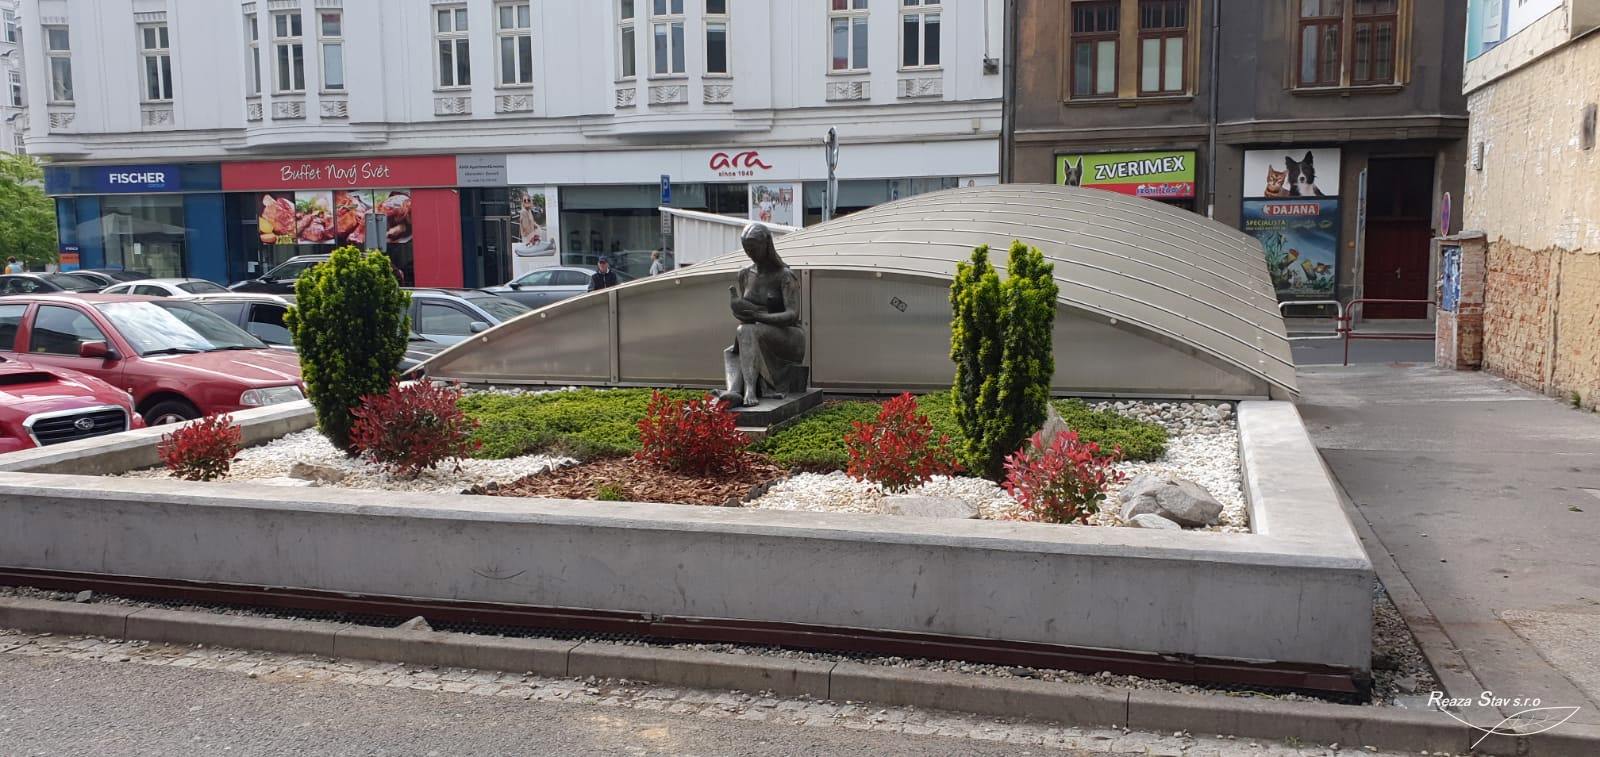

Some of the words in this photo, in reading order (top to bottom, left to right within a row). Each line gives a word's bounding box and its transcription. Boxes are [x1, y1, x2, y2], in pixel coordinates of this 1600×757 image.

[709, 151, 773, 170] ara
[1094, 155, 1186, 180] ZVERIMEX
[109, 172, 165, 184] FISCHER
[280, 164, 321, 181] Buffet
[325, 163, 357, 185] Nový
[361, 161, 390, 179] Svět
[1272, 204, 1316, 215] DAJANA
